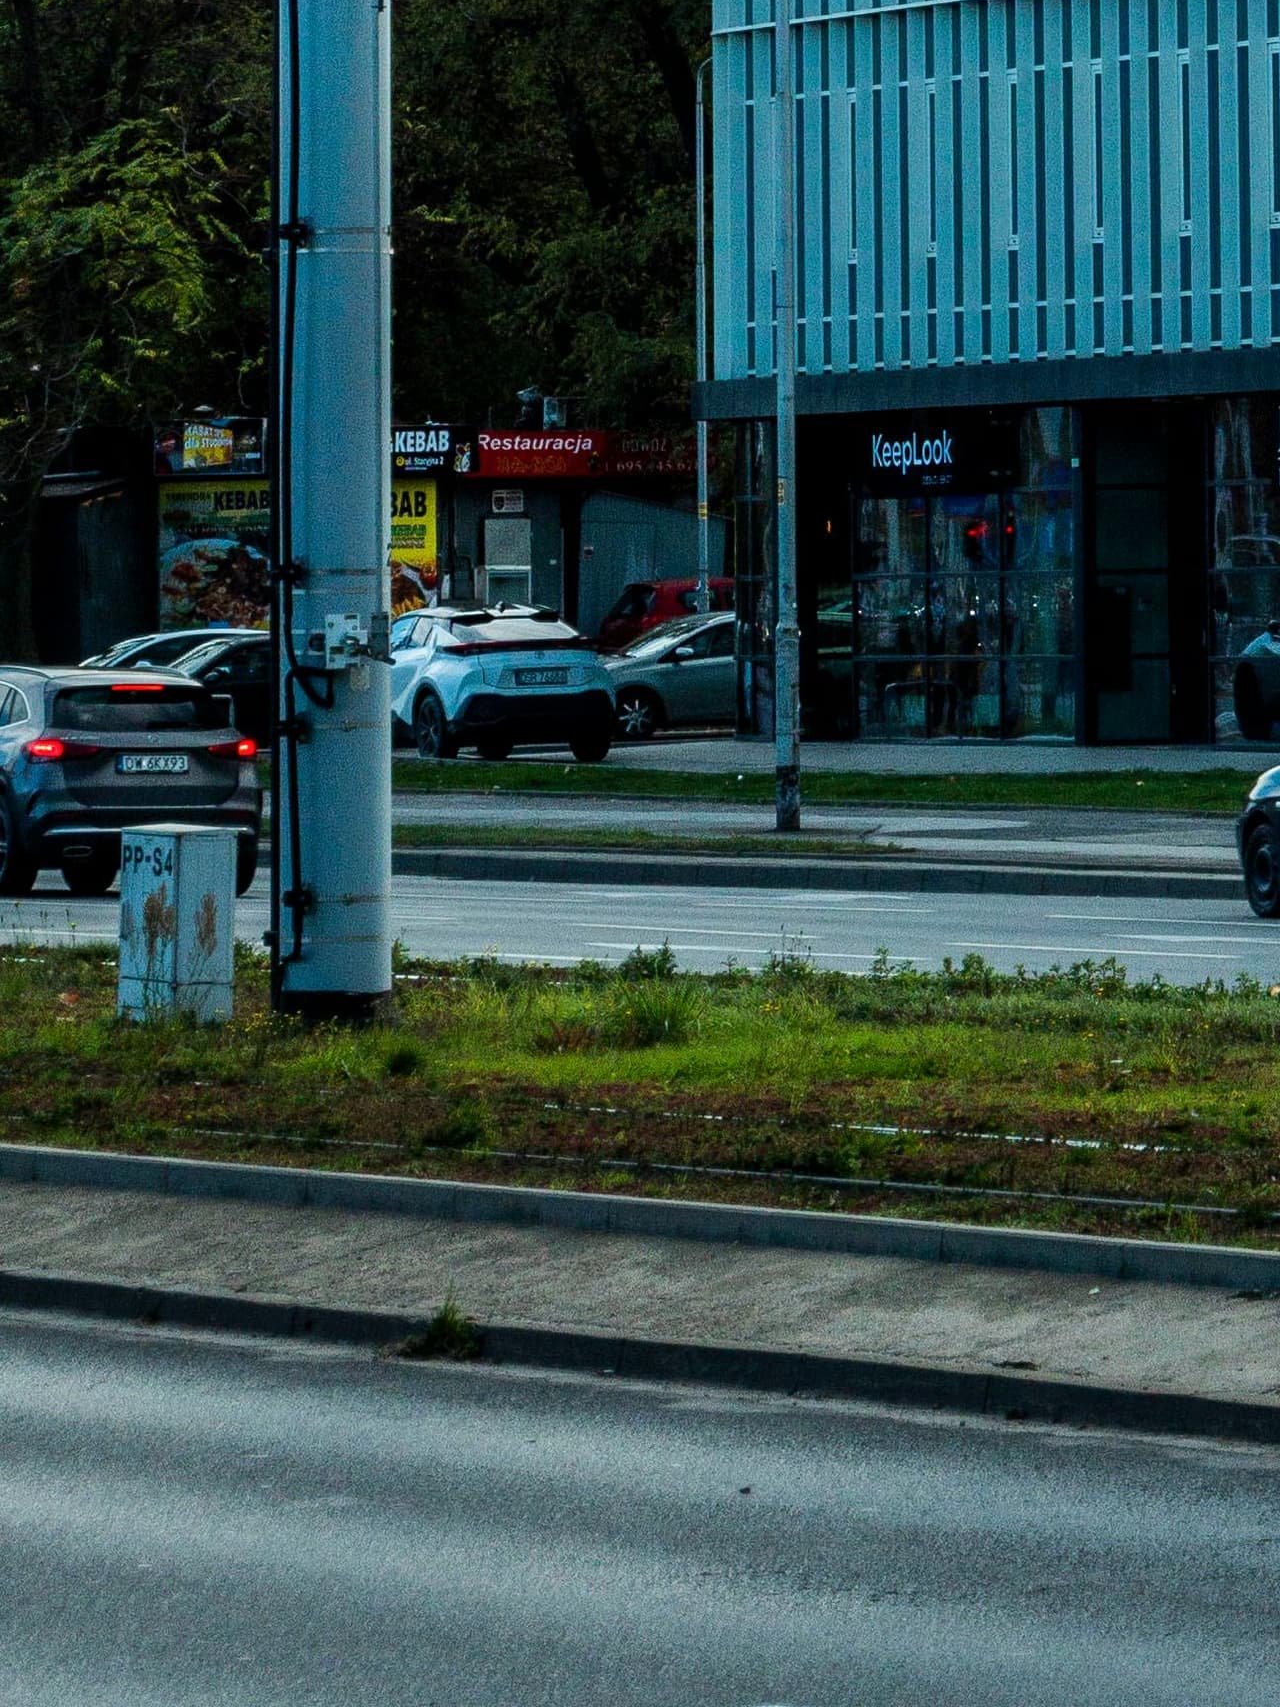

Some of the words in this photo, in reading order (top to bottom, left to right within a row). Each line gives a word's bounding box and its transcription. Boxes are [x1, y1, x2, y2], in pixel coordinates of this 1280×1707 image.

[395, 430, 450, 453] KEBAB
[478, 434, 593, 454] Restauracja
[872, 429, 953, 476] KeepLook
[122, 845, 173, 877] PP-S4
